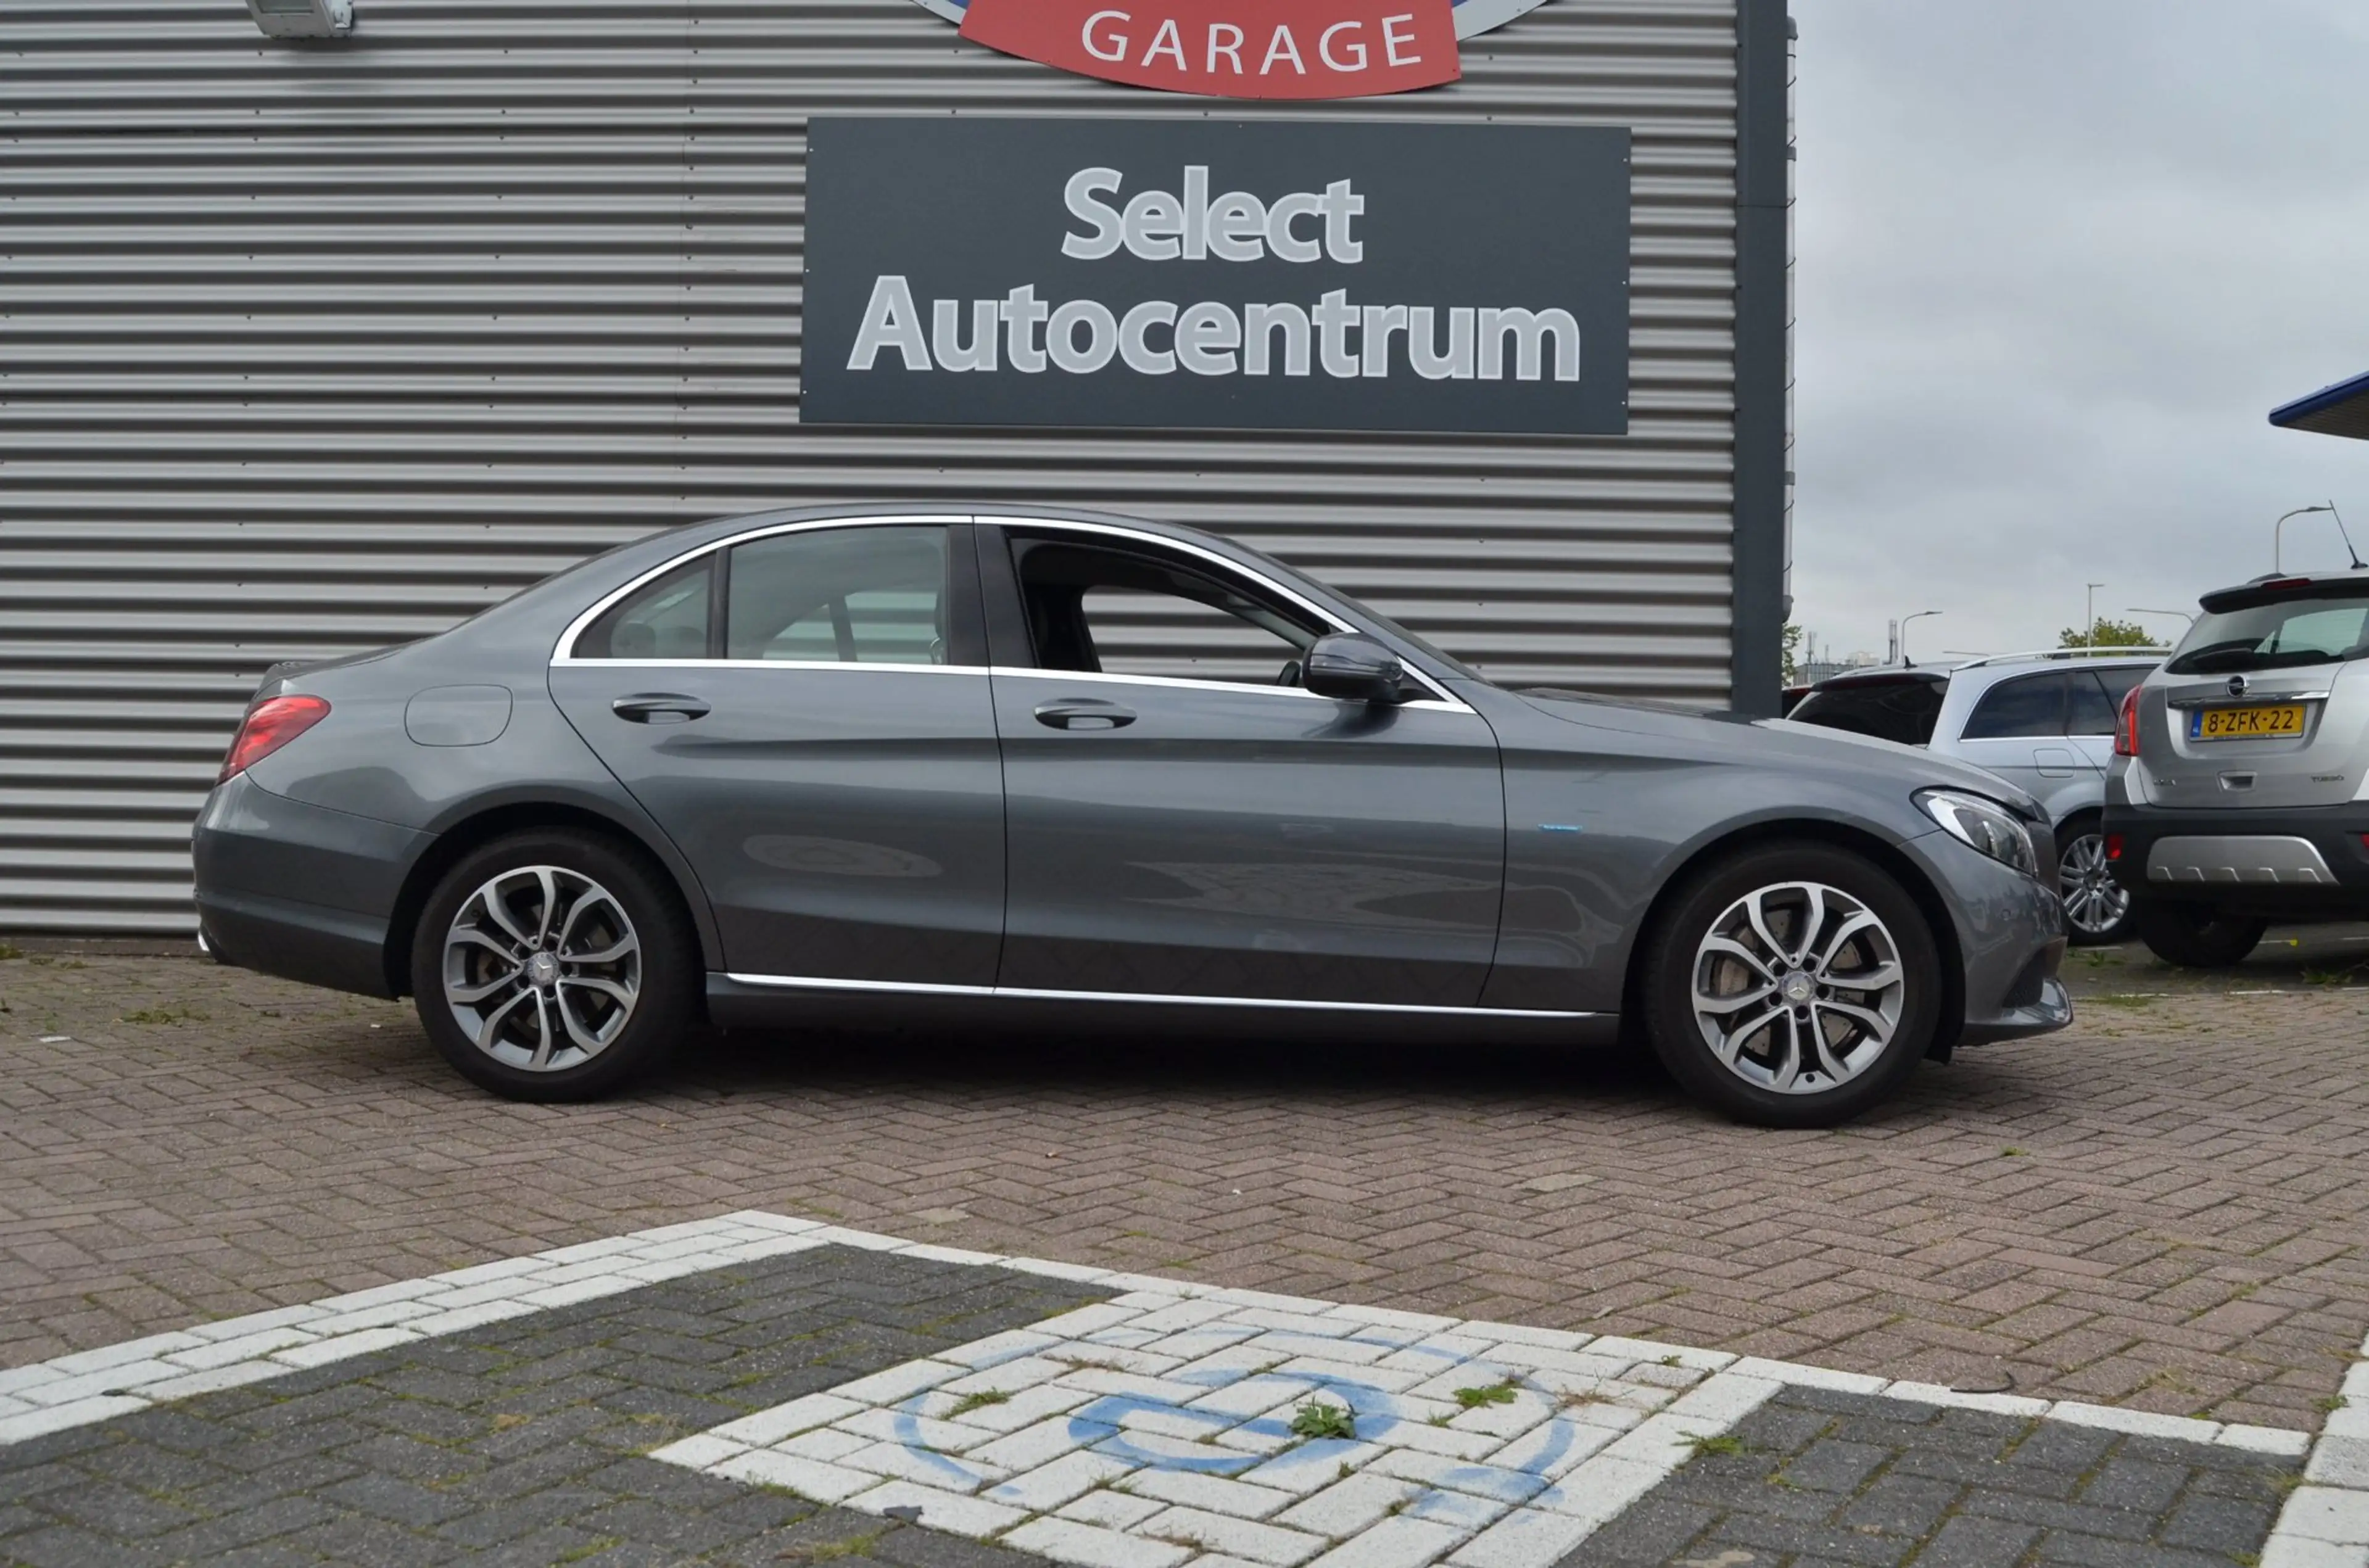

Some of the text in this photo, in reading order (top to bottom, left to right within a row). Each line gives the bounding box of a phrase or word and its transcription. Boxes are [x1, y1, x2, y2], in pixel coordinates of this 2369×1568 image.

[1081, 10, 1422, 75] GARAGE
[1060, 164, 1365, 265] Select
[846, 274, 1581, 382] Autocentrum
[2208, 710, 2294, 733] 8-ZFK-22
